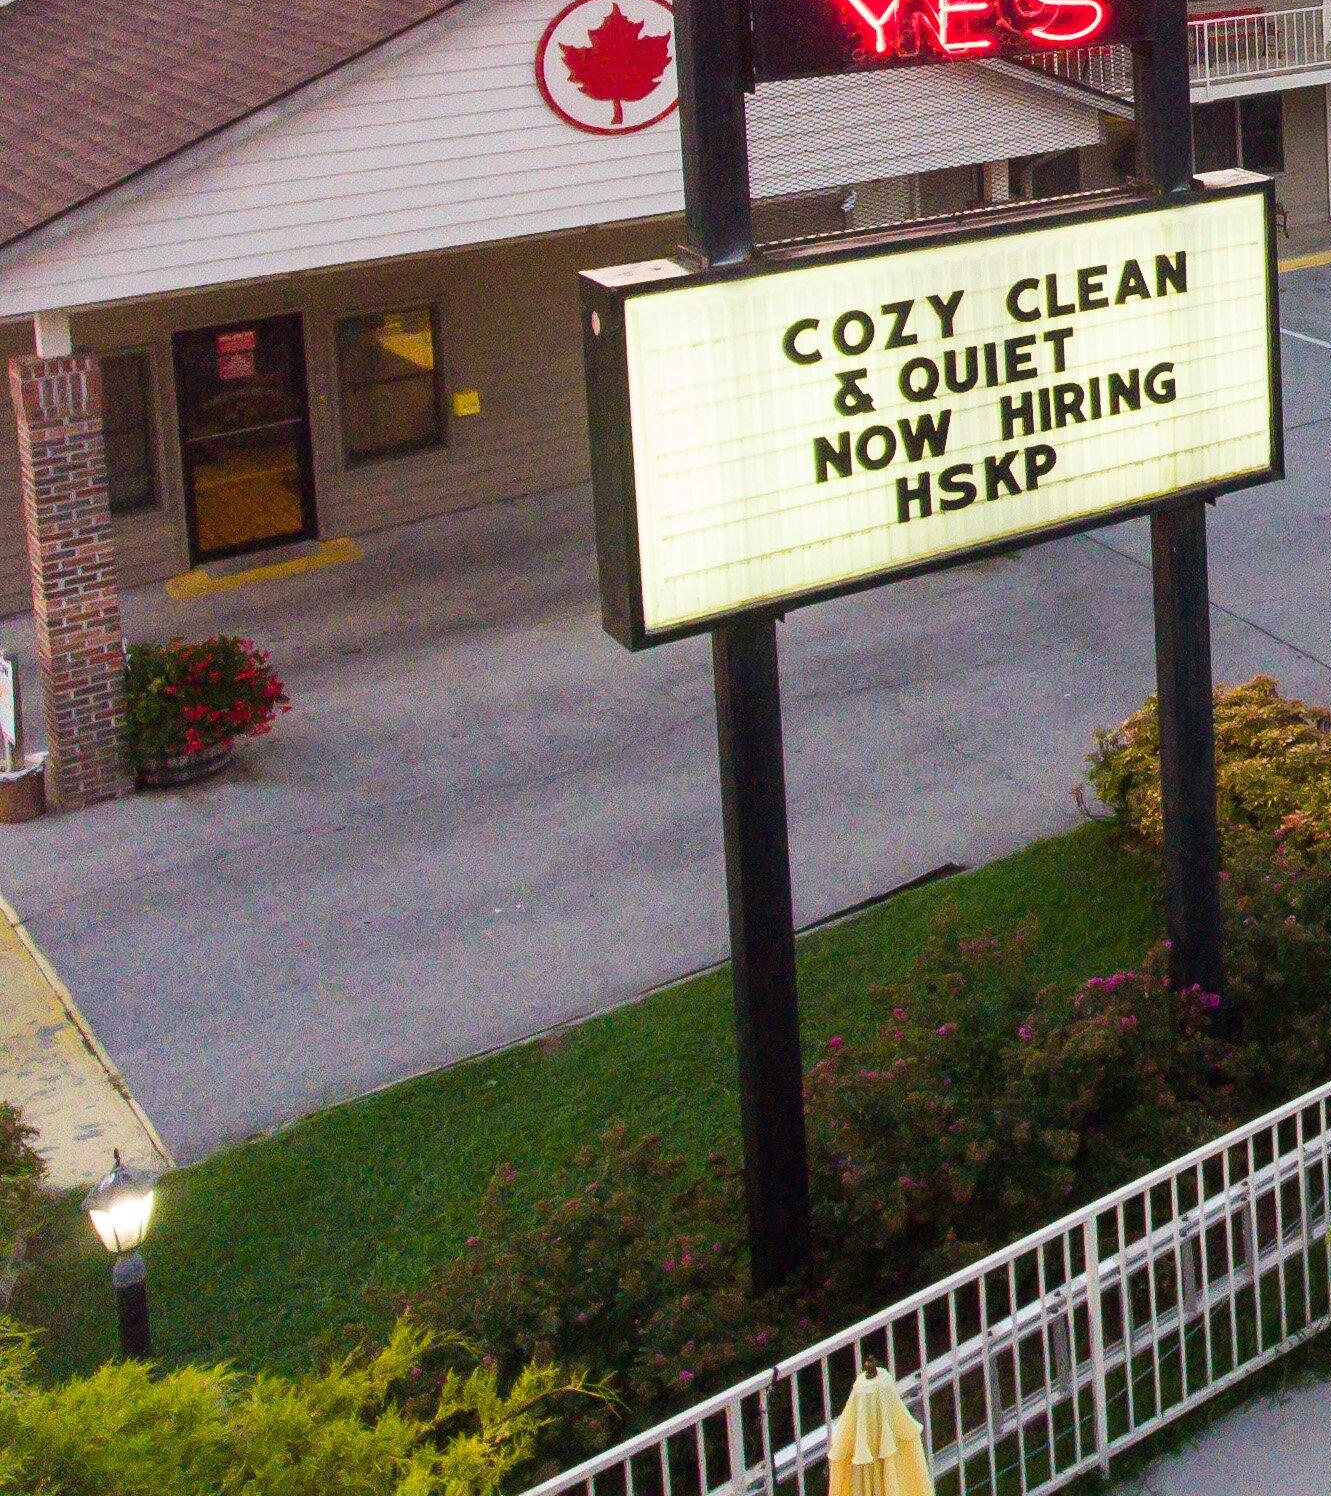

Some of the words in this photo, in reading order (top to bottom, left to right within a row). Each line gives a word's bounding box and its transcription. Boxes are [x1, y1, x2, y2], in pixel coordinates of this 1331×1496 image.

[781, 290, 966, 364] COZY
[1006, 250, 1188, 323] CLEAN
[834, 370, 873, 416] &
[898, 327, 1075, 403] QUIET
[814, 410, 951, 484] NOW
[1001, 362, 1177, 441] HIRING
[897, 445, 1057, 523] HSKP
